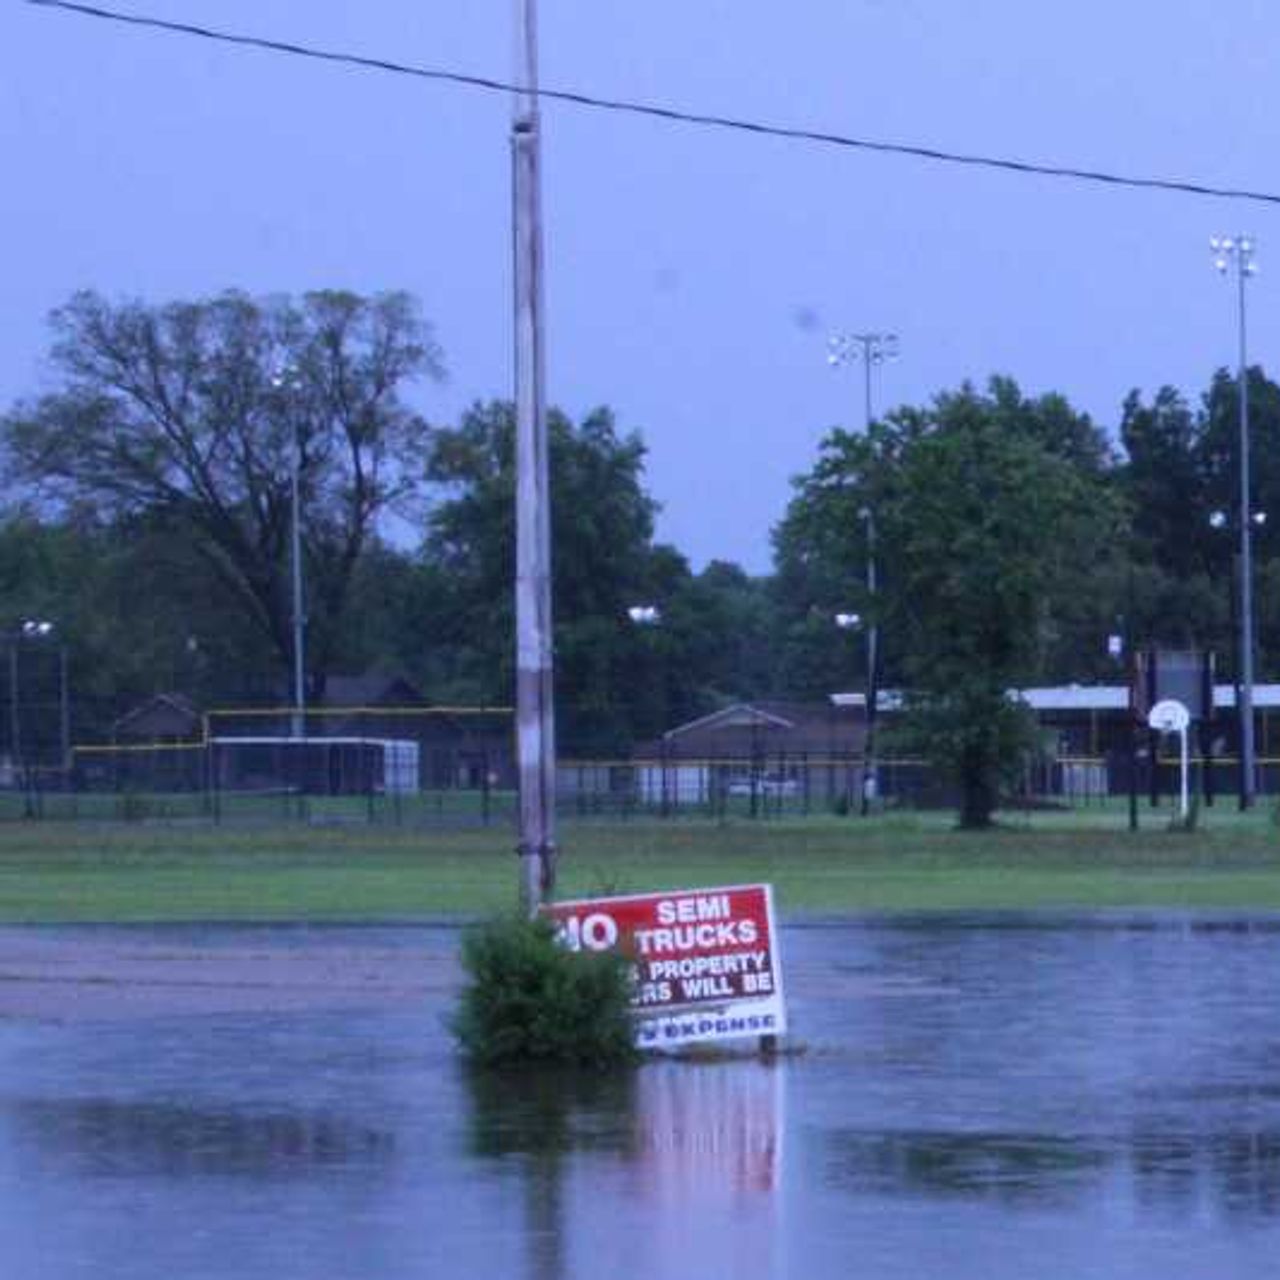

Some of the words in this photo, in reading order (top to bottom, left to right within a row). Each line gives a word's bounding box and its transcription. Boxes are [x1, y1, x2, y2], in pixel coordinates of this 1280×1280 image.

[657, 895, 731, 925] SEMI
[634, 919, 758, 954] TRUCKS
[649, 951, 768, 982] PROPERTY
[682, 976, 734, 998] WILL
[743, 972, 772, 993] BE
